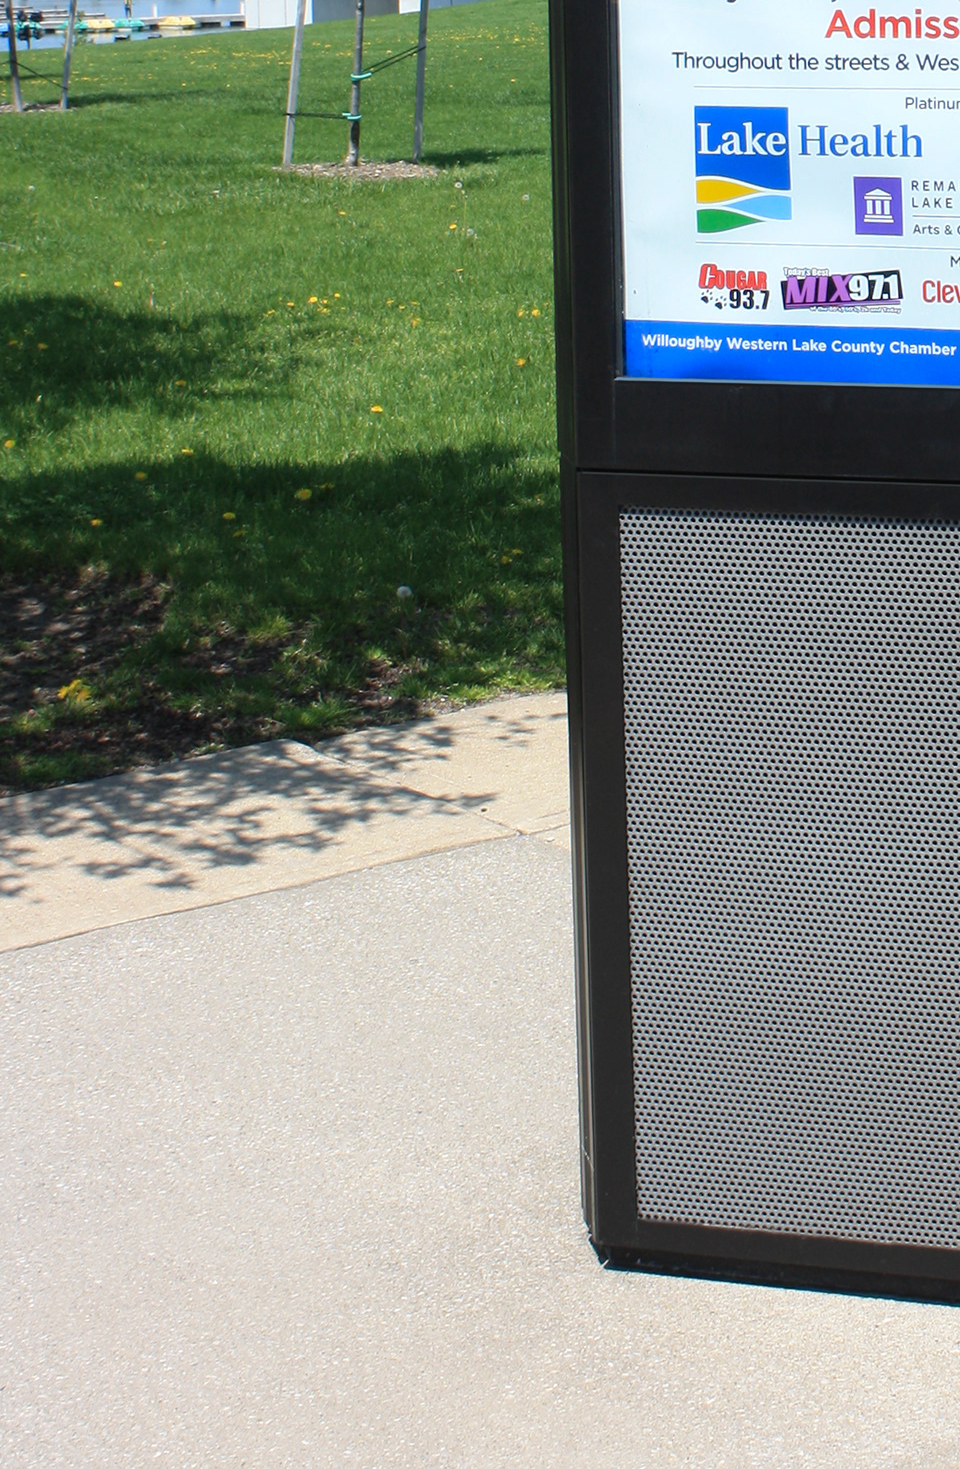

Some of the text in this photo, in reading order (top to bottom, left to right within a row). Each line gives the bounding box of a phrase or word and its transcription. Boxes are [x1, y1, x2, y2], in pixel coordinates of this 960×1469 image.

[672, 51, 781, 73] Throughout
[789, 52, 819, 70] the
[825, 54, 890, 71] streets
[895, 54, 910, 71] &
[916, 54, 959, 71] Wes
[697, 121, 923, 158] Lake Health
[912, 197, 953, 209] LAKE
[913, 224, 939, 235] Arts
[944, 224, 952, 235] &
[699, 263, 767, 290] COUGAR
[729, 289, 770, 309] 93.7
[641, 334, 723, 352] Willoughby
[726, 336, 788, 351] Western
[792, 338, 827, 352] Lake
[831, 339, 885, 356] County
[889, 340, 957, 356] Chamber
